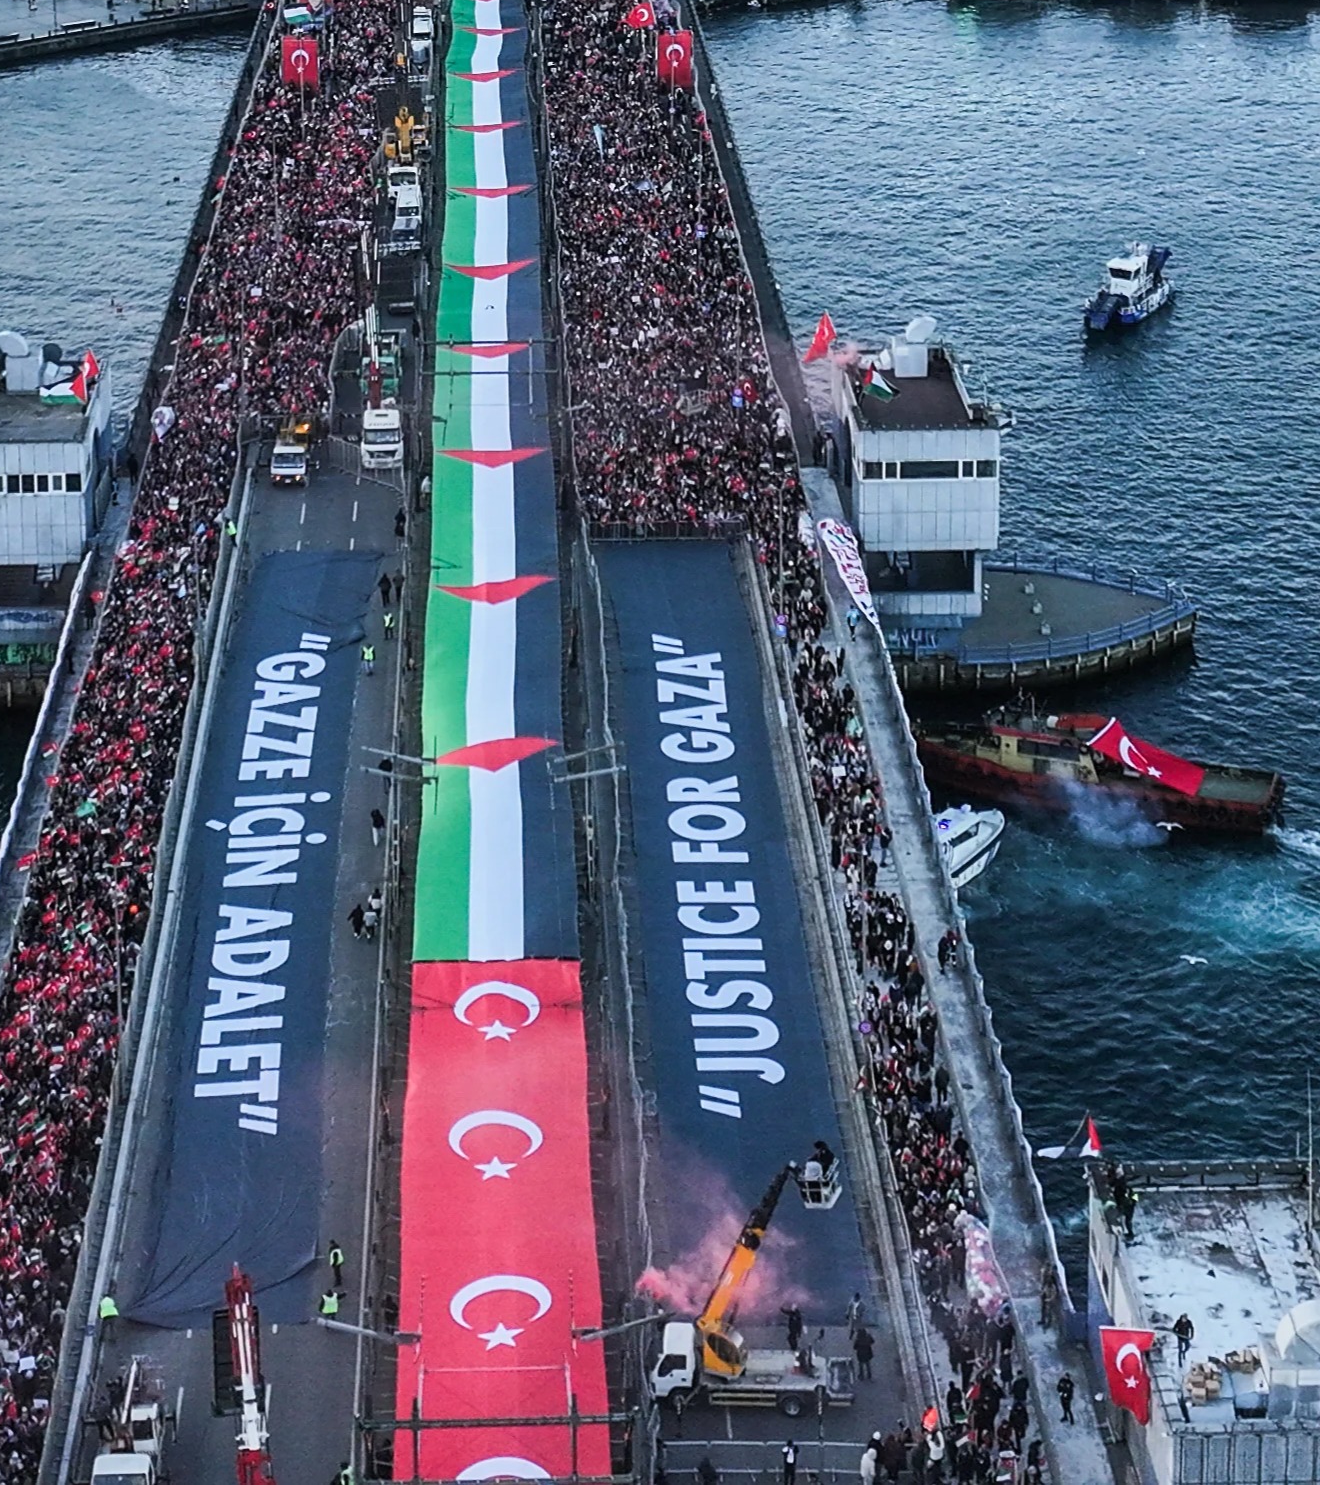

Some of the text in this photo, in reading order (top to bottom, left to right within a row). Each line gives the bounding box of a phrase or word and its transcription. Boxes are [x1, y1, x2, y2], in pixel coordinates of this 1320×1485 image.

[194, 632, 331, 1135] "GAZZE İÇİN ADALET"
[651, 633, 786, 1119] "JUSTICE FOR GAZA"
